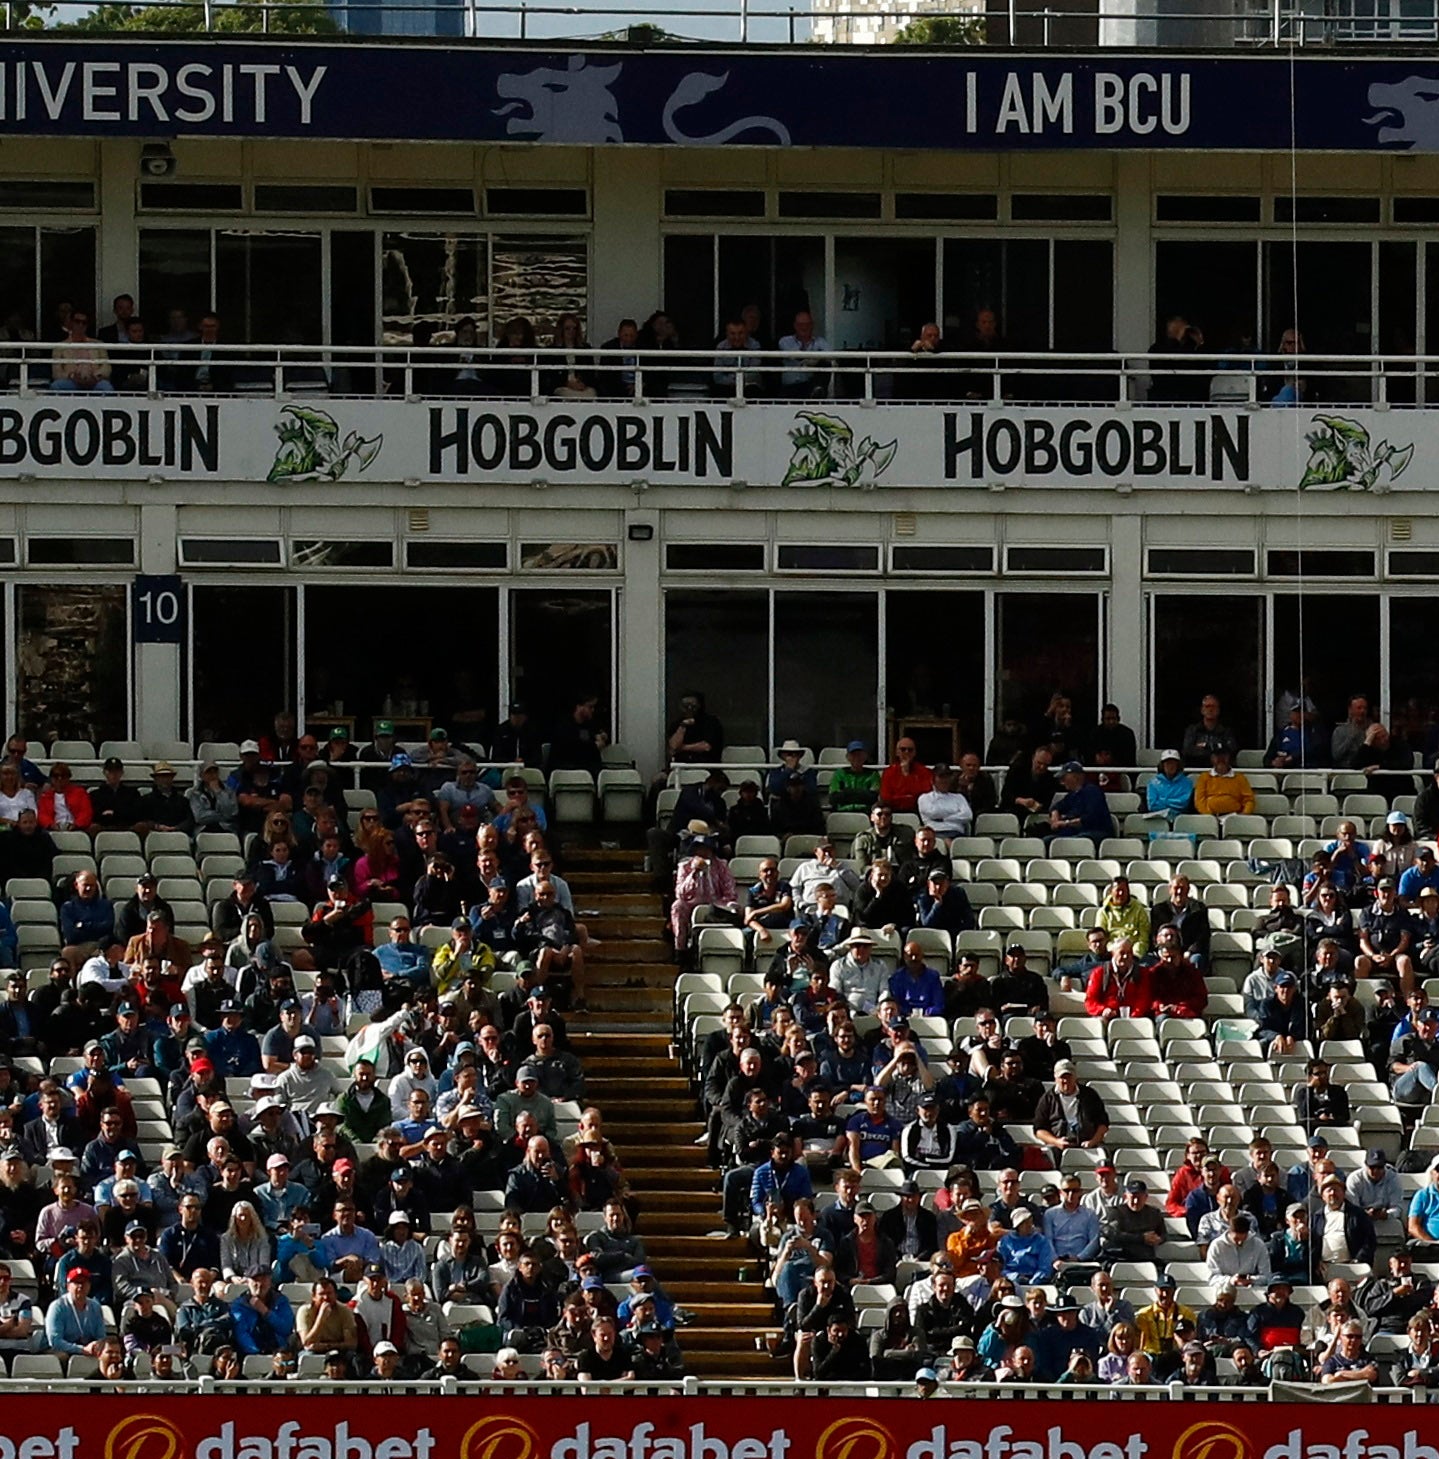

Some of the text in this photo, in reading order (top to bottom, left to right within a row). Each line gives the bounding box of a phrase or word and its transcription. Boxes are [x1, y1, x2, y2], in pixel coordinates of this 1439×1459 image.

[967, 73, 1189, 134] I AM BCU
[429, 407, 733, 477] HOBGOBLIN
[943, 412, 1250, 481] HOBGOBLIN
[139, 591, 177, 623] 10
